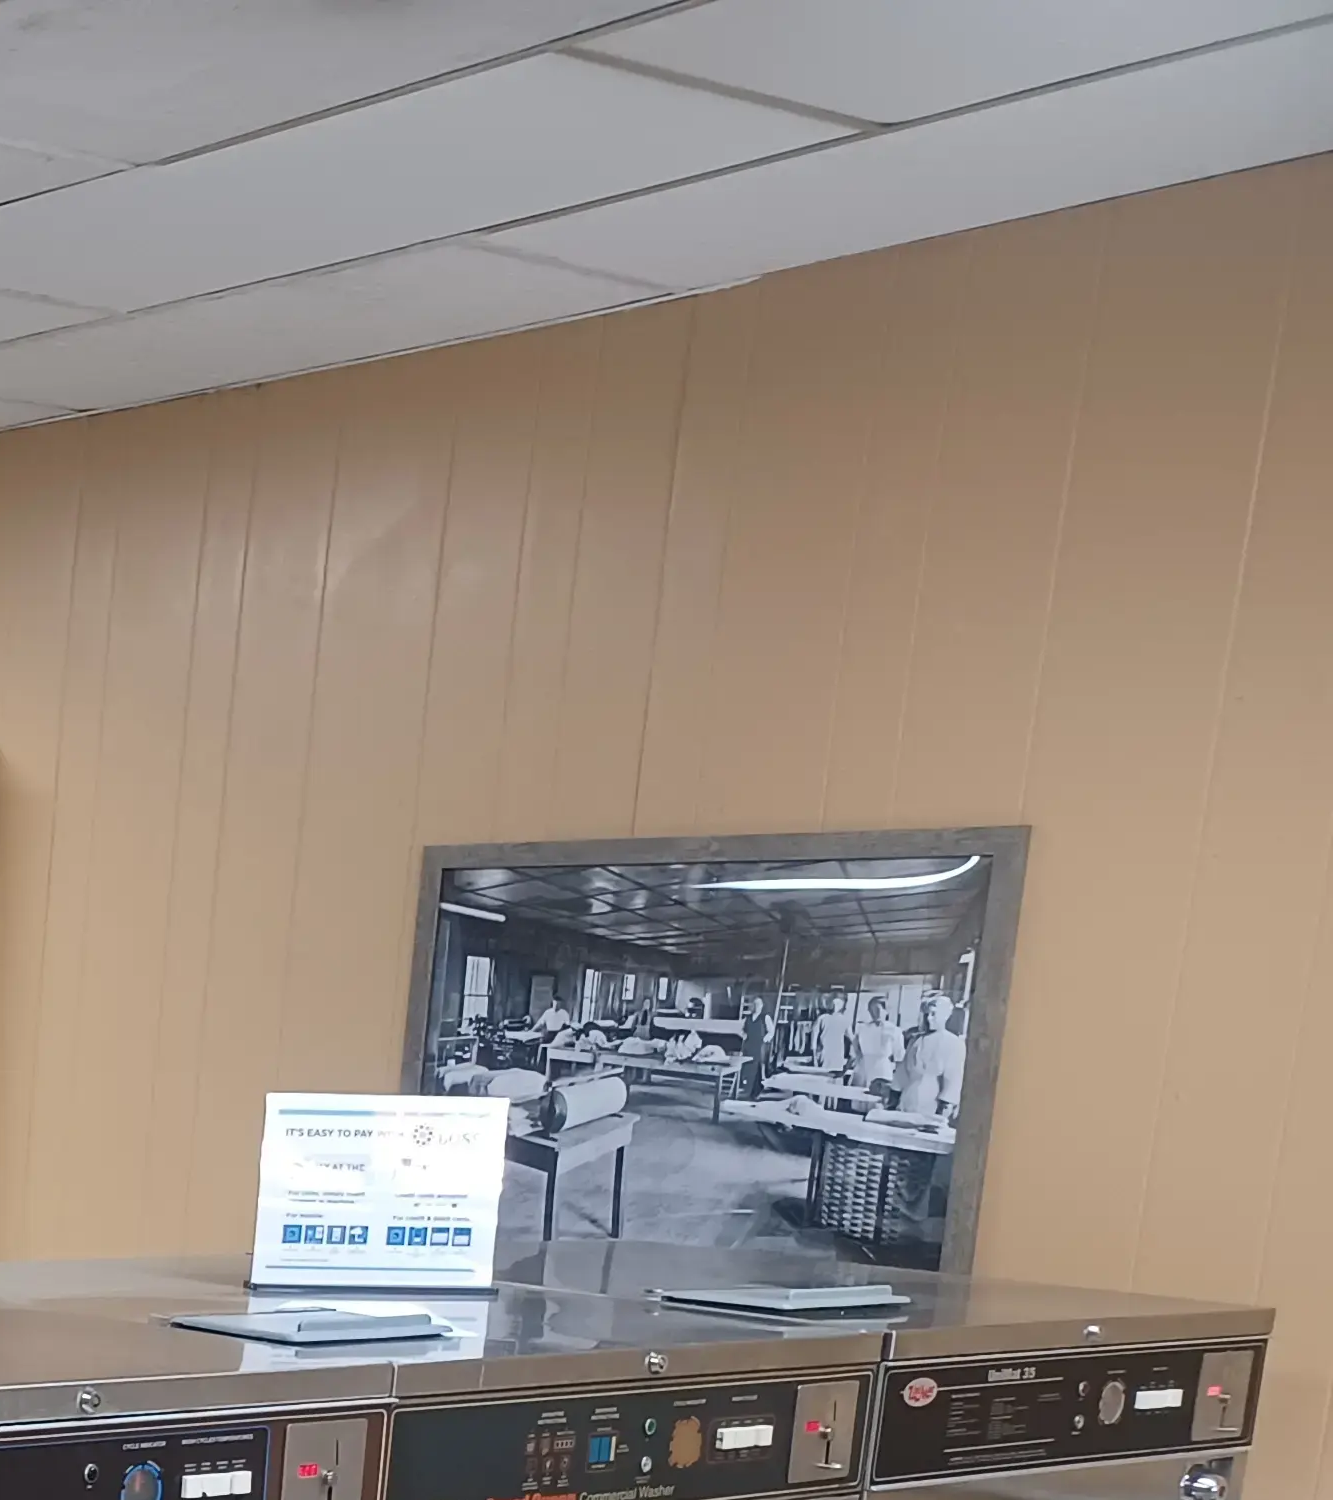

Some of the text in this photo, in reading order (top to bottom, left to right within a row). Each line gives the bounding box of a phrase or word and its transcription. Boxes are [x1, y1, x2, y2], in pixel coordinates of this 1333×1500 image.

[286, 1128, 304, 1137] IT'S
[307, 1128, 335, 1138] EASY
[337, 1128, 351, 1138] TO
[354, 1129, 374, 1139] PAY
[638, 1484, 675, 1499] Washer
